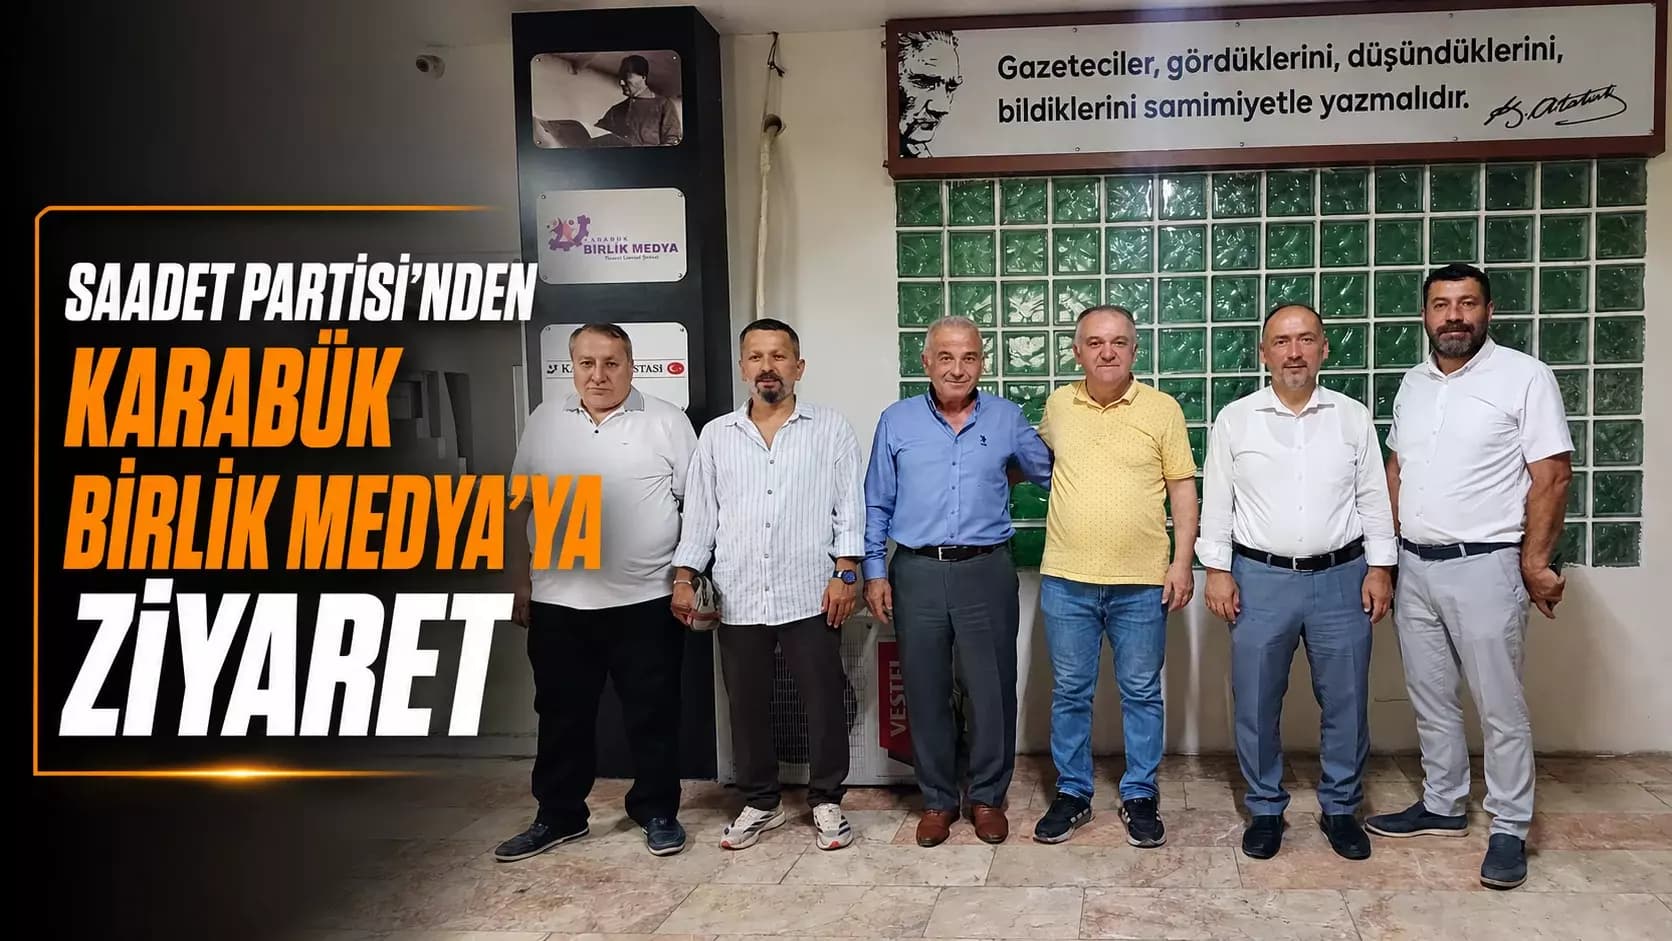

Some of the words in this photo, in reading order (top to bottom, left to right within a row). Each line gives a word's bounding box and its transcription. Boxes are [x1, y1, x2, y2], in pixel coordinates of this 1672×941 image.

[997, 50, 1160, 80] Gazeteciler,
[1167, 43, 1340, 81] gördüklerini,
[1347, 35, 1564, 73] düşündüklerini,
[998, 94, 1137, 123] bildiklerini
[1144, 89, 1313, 123] samimiyetle
[1319, 84, 1470, 120] yazmalıdır.
[632, 243, 679, 254] MEDYA
